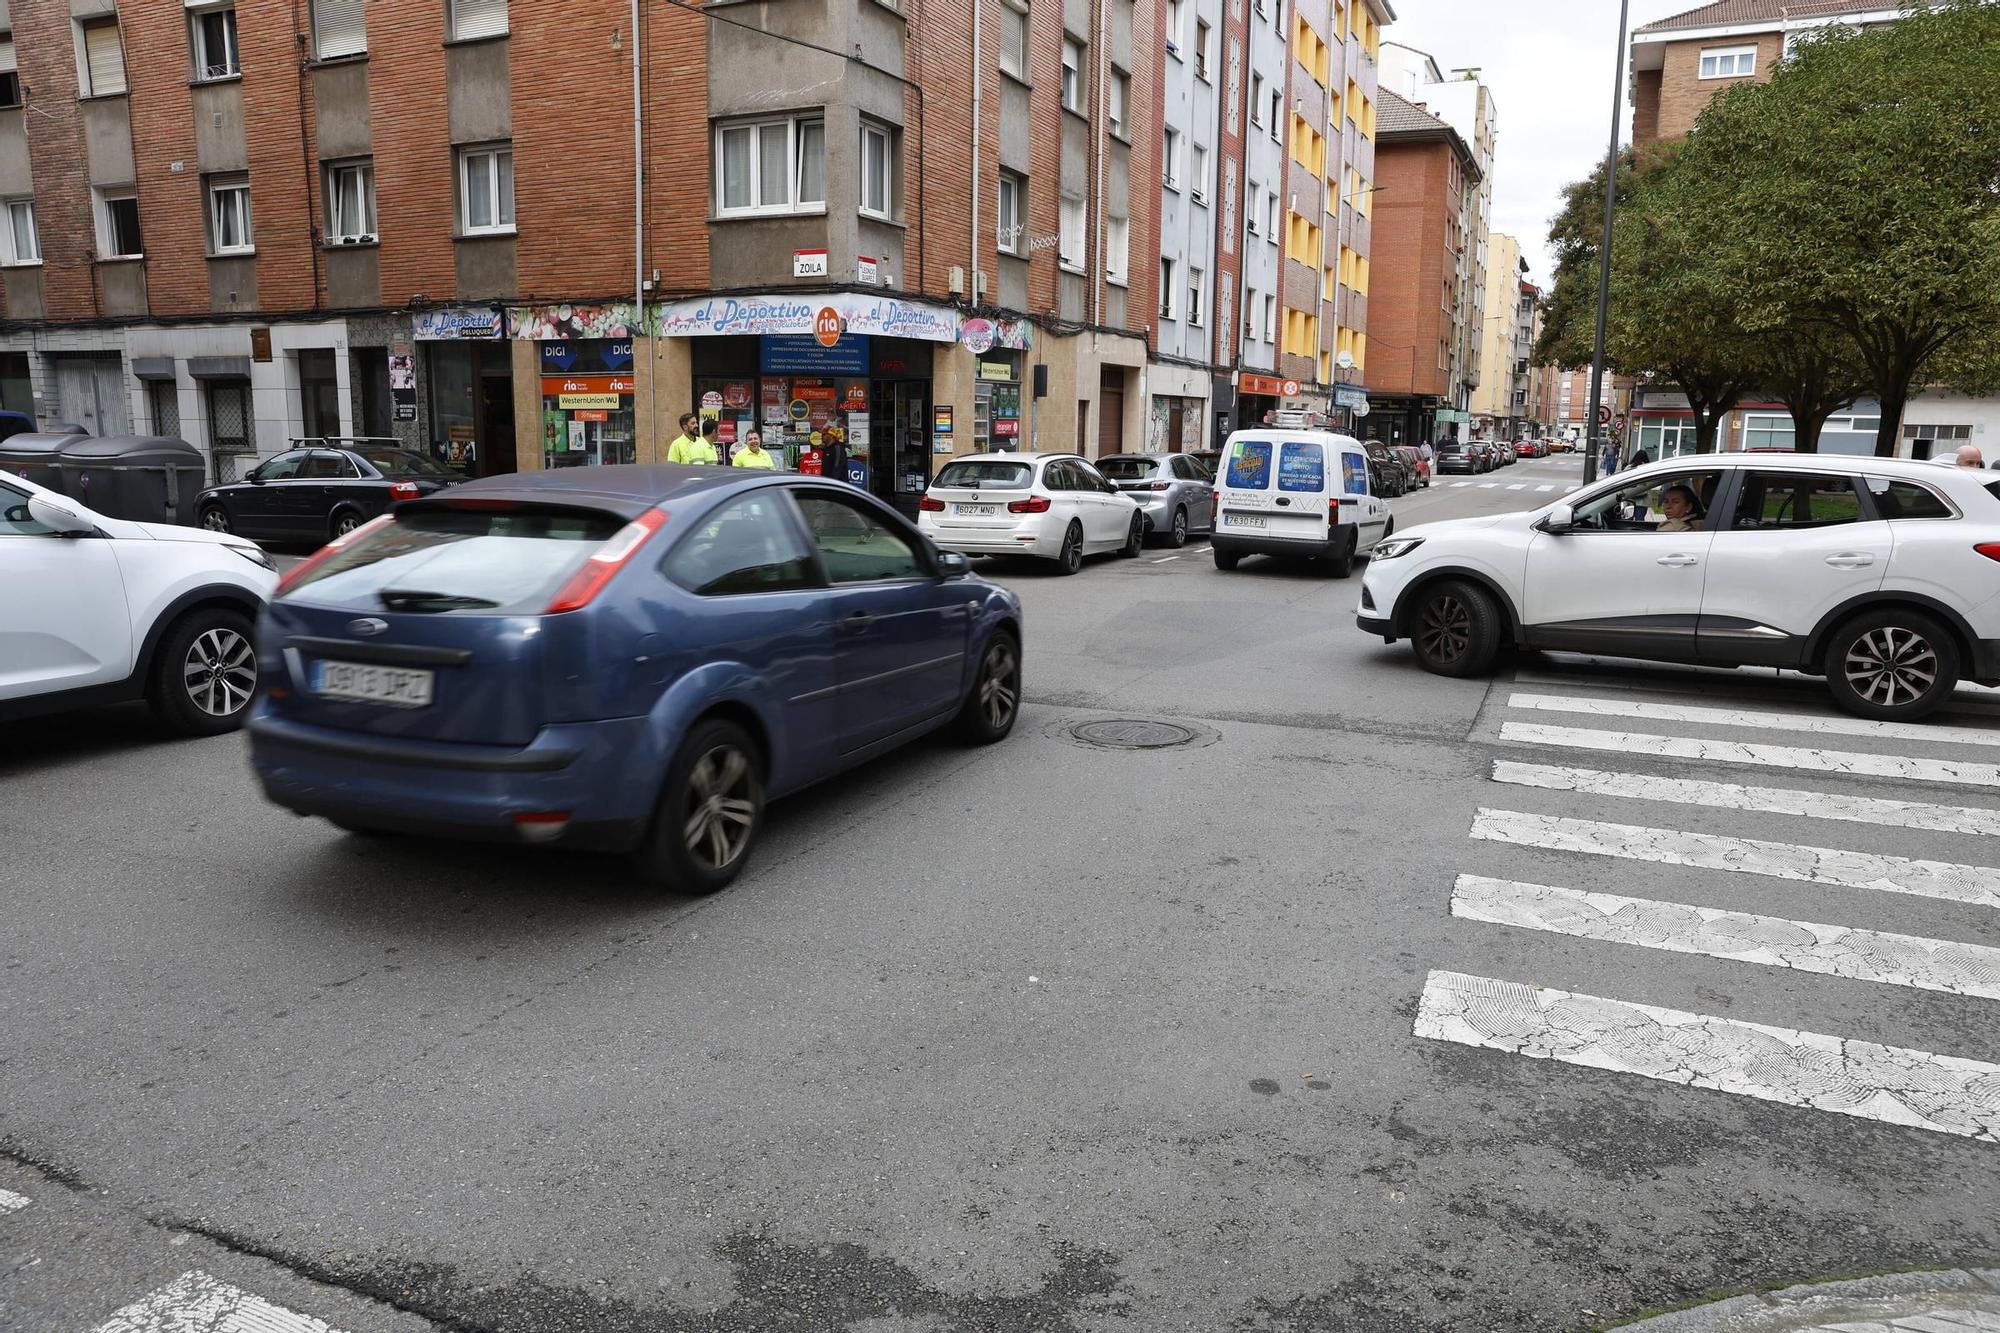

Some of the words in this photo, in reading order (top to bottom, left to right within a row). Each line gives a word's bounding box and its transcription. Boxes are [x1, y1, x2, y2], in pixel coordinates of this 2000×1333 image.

[800, 263, 822, 273] ZOILA
[696, 301, 712, 321] el
[714, 299, 811, 331] Deportivo
[871, 301, 882, 321] el
[883, 301, 936, 332] Deportivo
[422, 312, 433, 328] el
[435, 312, 494, 335] Deportiv
[819, 311, 838, 333] ria
[462, 328, 492, 336] PELUQUER
[545, 347, 565, 356] DIGI
[563, 380, 577, 391] ria
[610, 379, 624, 390] ria
[763, 383, 787, 391] HIELO
[848, 386, 864, 397] ria
[848, 469, 864, 480] IGI
[960, 505, 978, 514] 6027
[980, 506, 995, 515] MND
[1230, 516, 1249, 525] 7630
[1250, 517, 1265, 526] FFX
